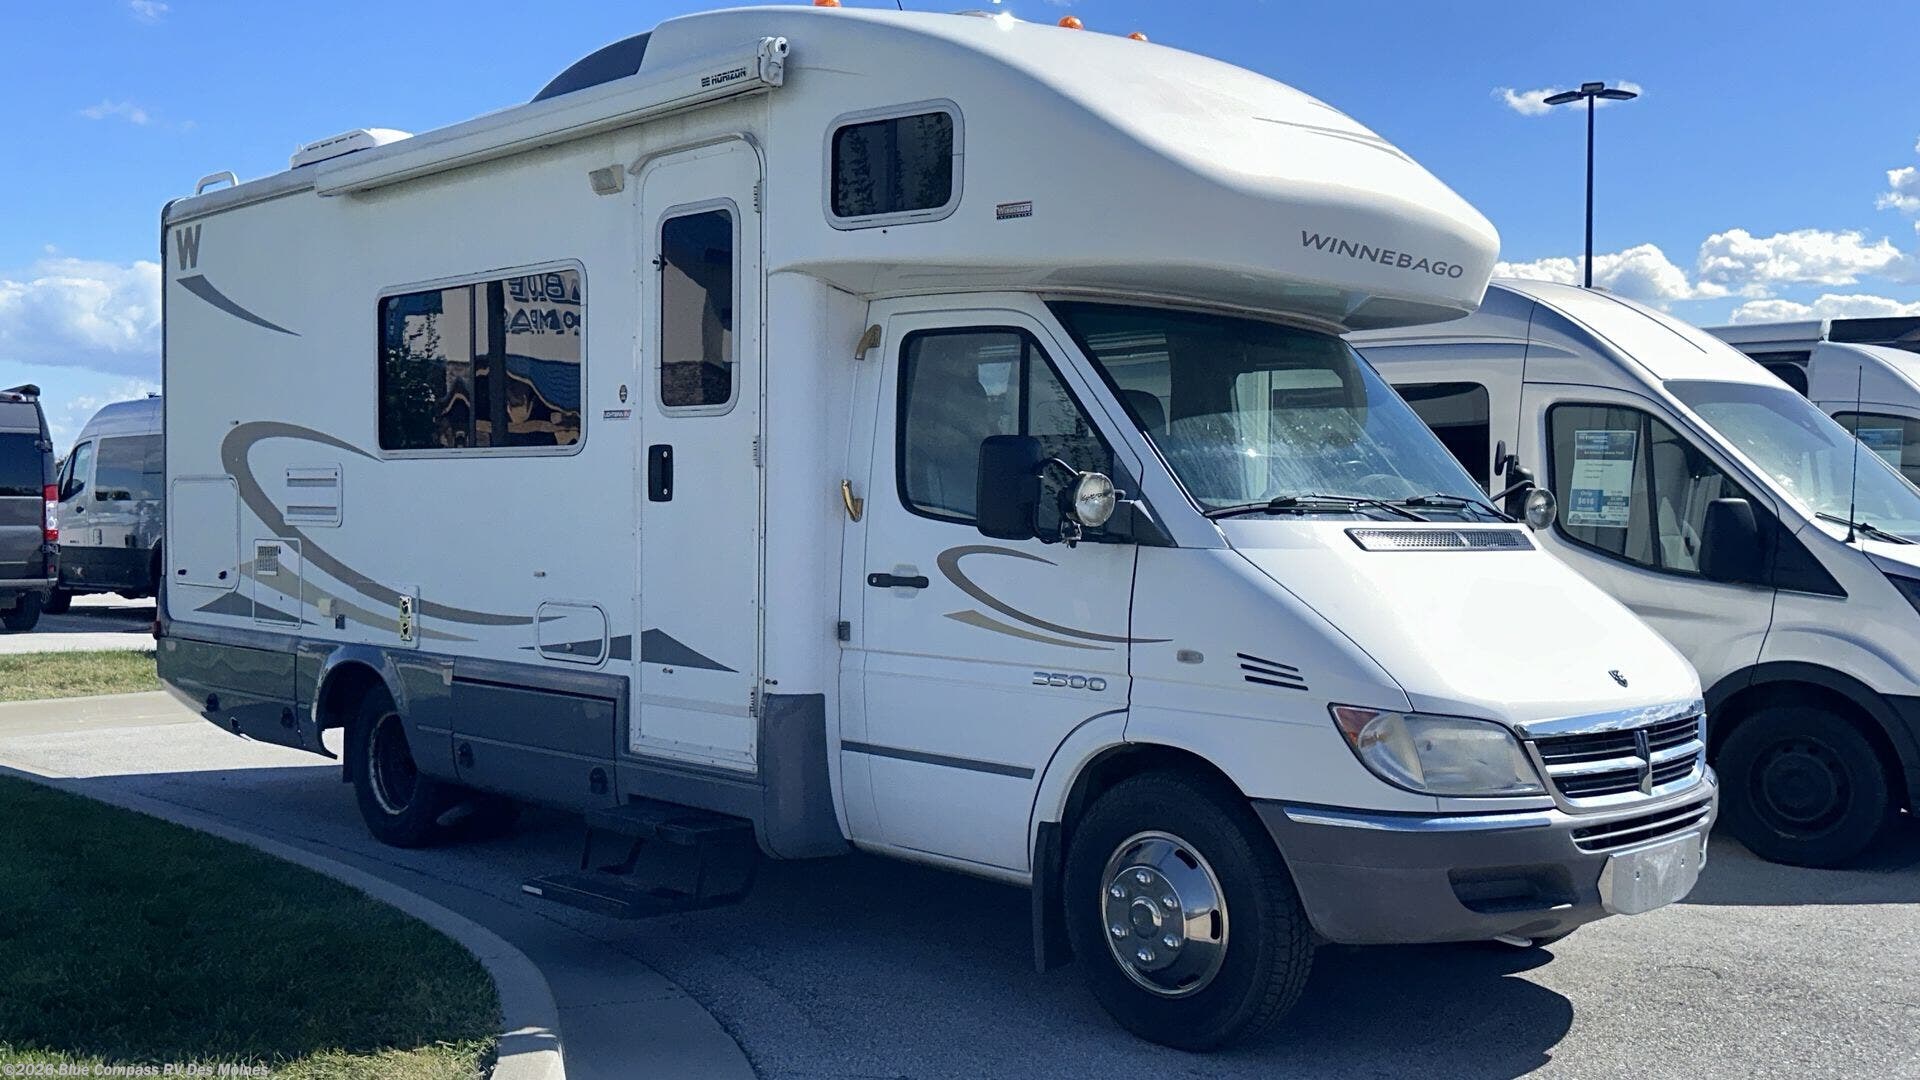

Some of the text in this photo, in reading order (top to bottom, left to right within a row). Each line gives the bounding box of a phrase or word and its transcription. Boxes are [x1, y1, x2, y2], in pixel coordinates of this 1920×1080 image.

[711, 67, 746, 85] HORIZON
[175, 223, 202, 271] W
[1301, 230, 1463, 279] WINNEBAGO
[1032, 671, 1107, 691] 3500
